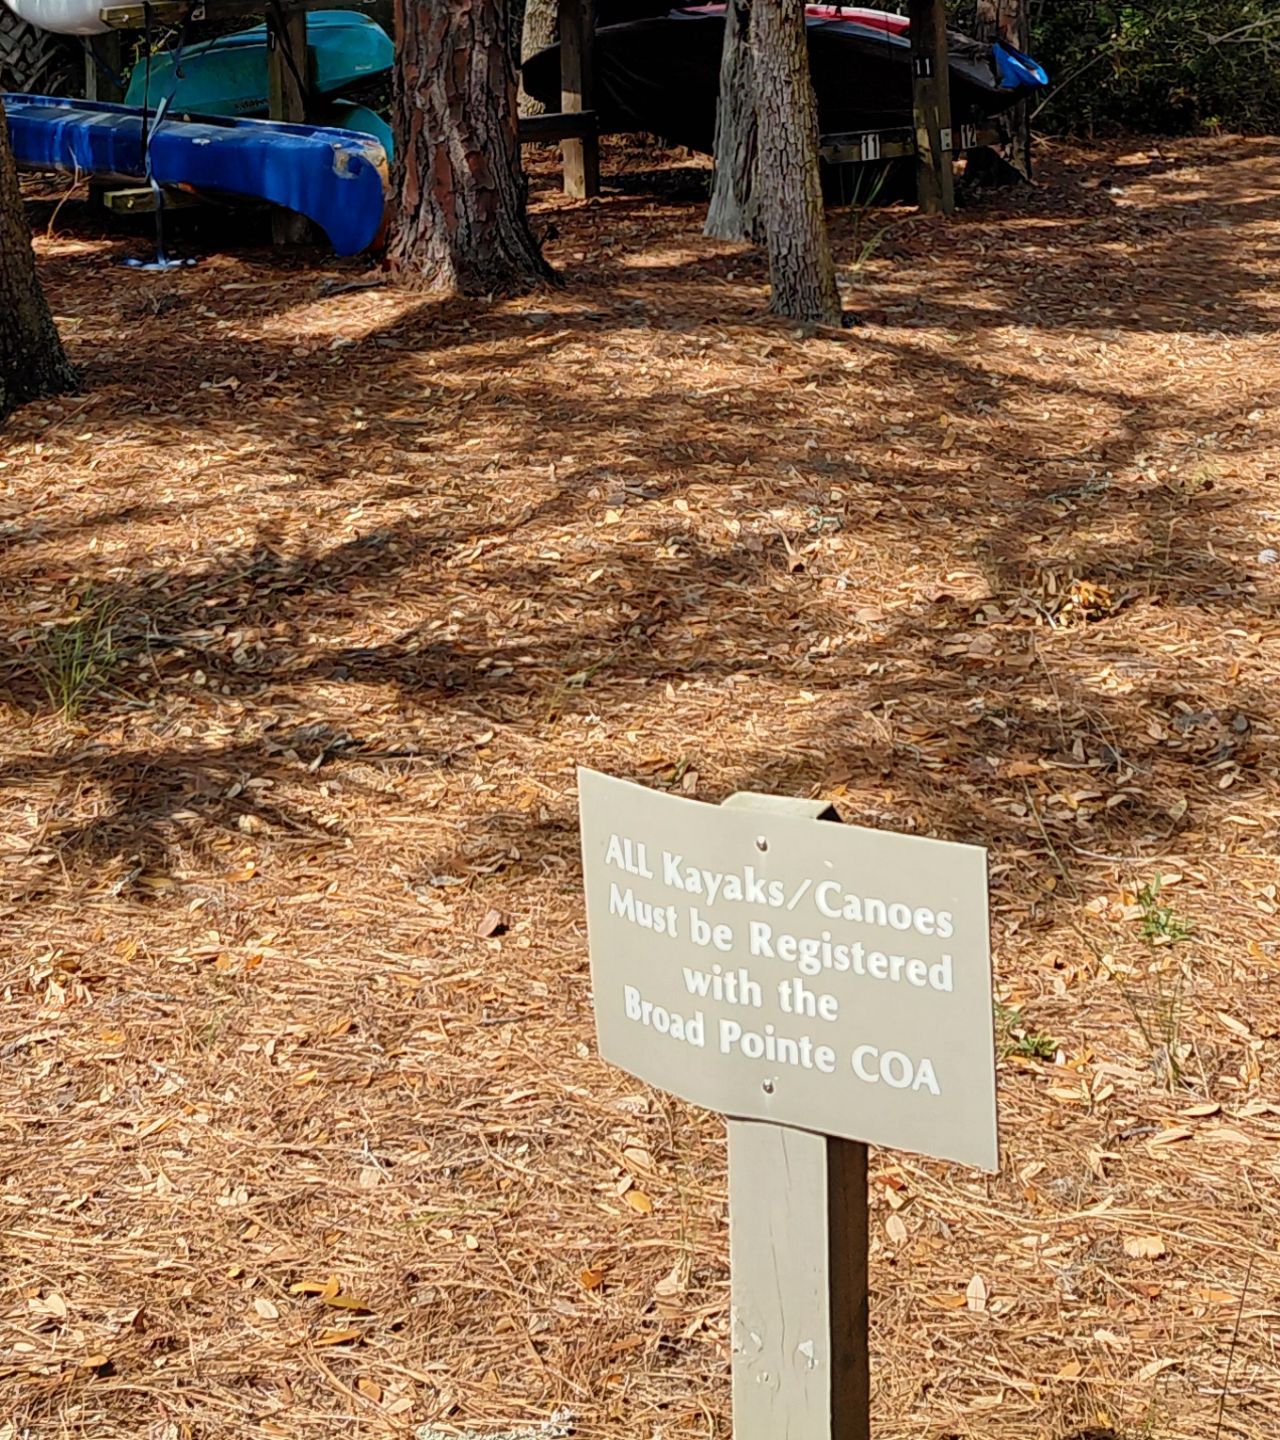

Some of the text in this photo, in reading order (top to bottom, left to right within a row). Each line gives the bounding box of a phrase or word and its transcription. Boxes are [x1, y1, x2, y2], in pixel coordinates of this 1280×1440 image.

[915, 58, 931, 76] 11
[862, 134, 879, 159] 11
[604, 834, 955, 939] ALL Kayaks/Canoes
[608, 883, 955, 993] Must be Registered
[682, 963, 840, 1022] with the
[623, 984, 941, 1096] Broad Pointe COA
